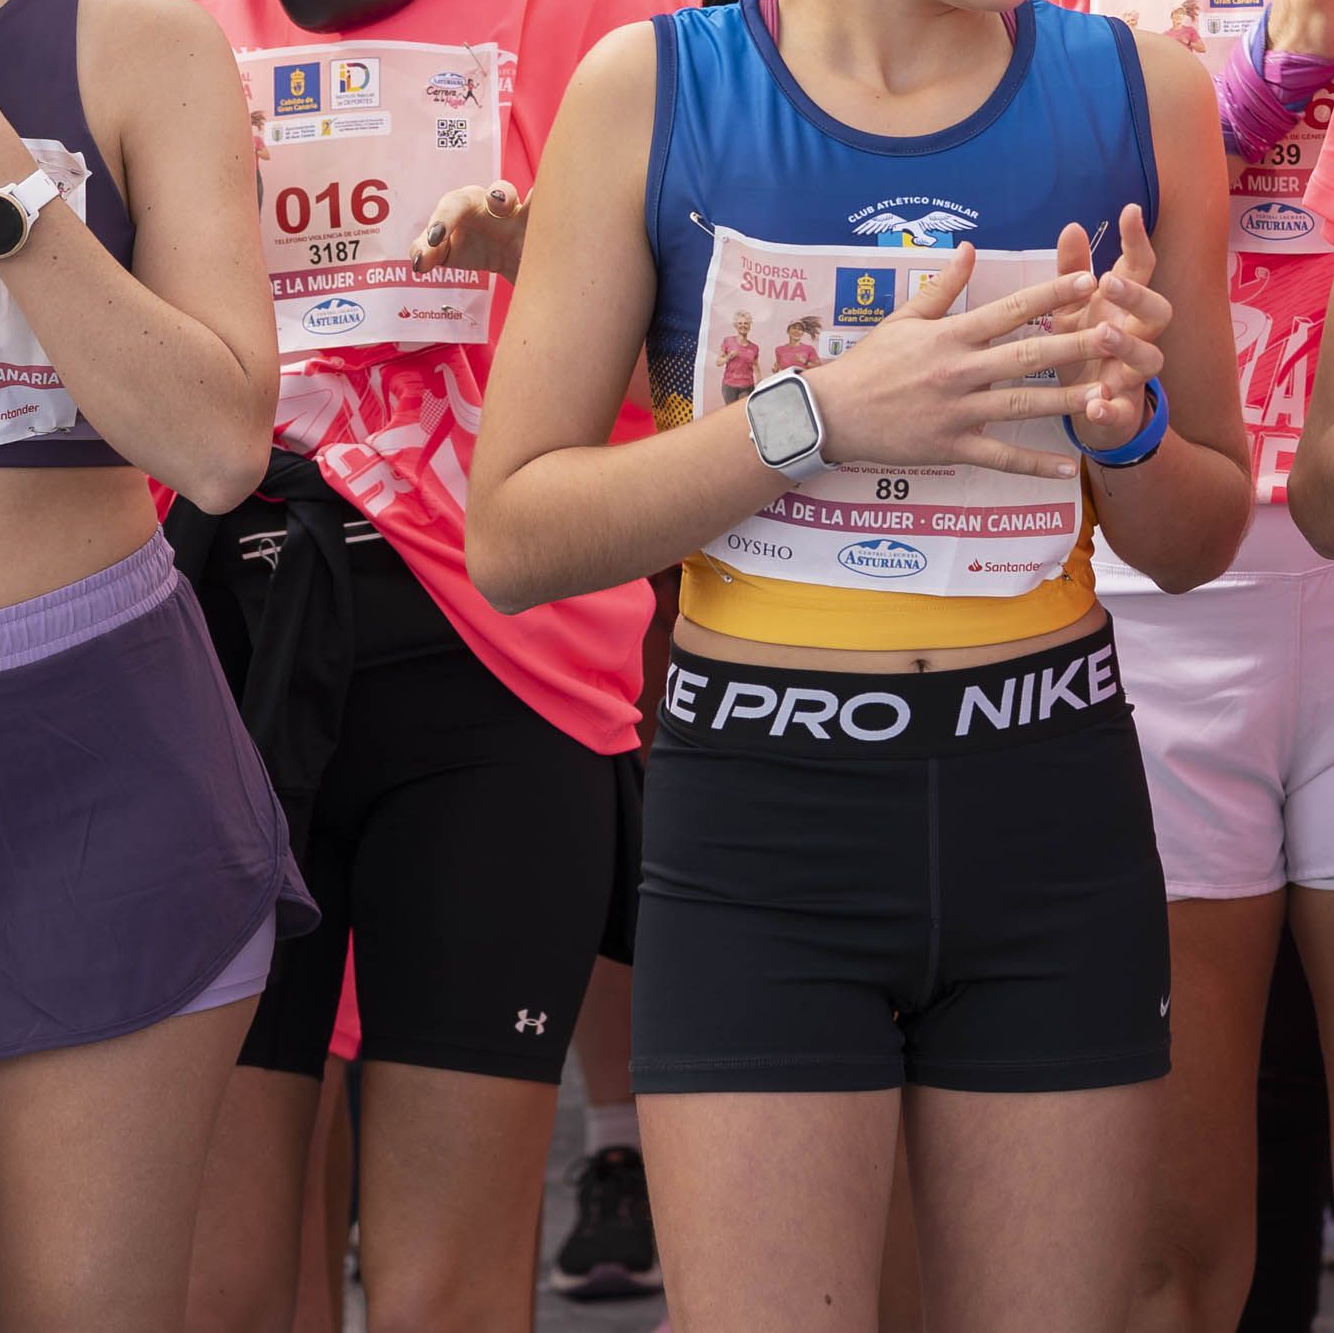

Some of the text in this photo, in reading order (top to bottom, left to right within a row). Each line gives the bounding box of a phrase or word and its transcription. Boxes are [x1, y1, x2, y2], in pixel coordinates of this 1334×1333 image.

[1247, 175, 1300, 192] MUJER
[275, 179, 390, 235] 016
[847, 196, 980, 224] CLUB ATLÉTICO INSULAR
[1245, 214, 1309, 231] ASTURIANA
[308, 240, 361, 265] 3187
[286, 277, 305, 293] LA
[308, 272, 355, 291] MUJER
[366, 267, 407, 284] GRAN
[741, 256, 808, 281] TU DORSAL
[740, 272, 808, 302] SUMA
[307, 312, 361, 328] ASTURIANA
[412, 309, 463, 320] Santander
[838, 314, 858, 323] Gran
[842, 307, 884, 316] Cabildo de
[861, 467, 907, 476] VIOLENCIA
[919, 467, 956, 477] GÉNERO
[875, 478, 910, 501] 89
[792, 501, 816, 522] DE
[820, 509, 844, 526] LA
[850, 509, 914, 530] MUJER
[932, 513, 982, 532] GRAN
[987, 511, 1064, 532] CANARIA
[727, 533, 794, 561] OYSHO
[845, 552, 920, 570] ASTURIANA
[711, 643, 1118, 741] PRO NIKE
